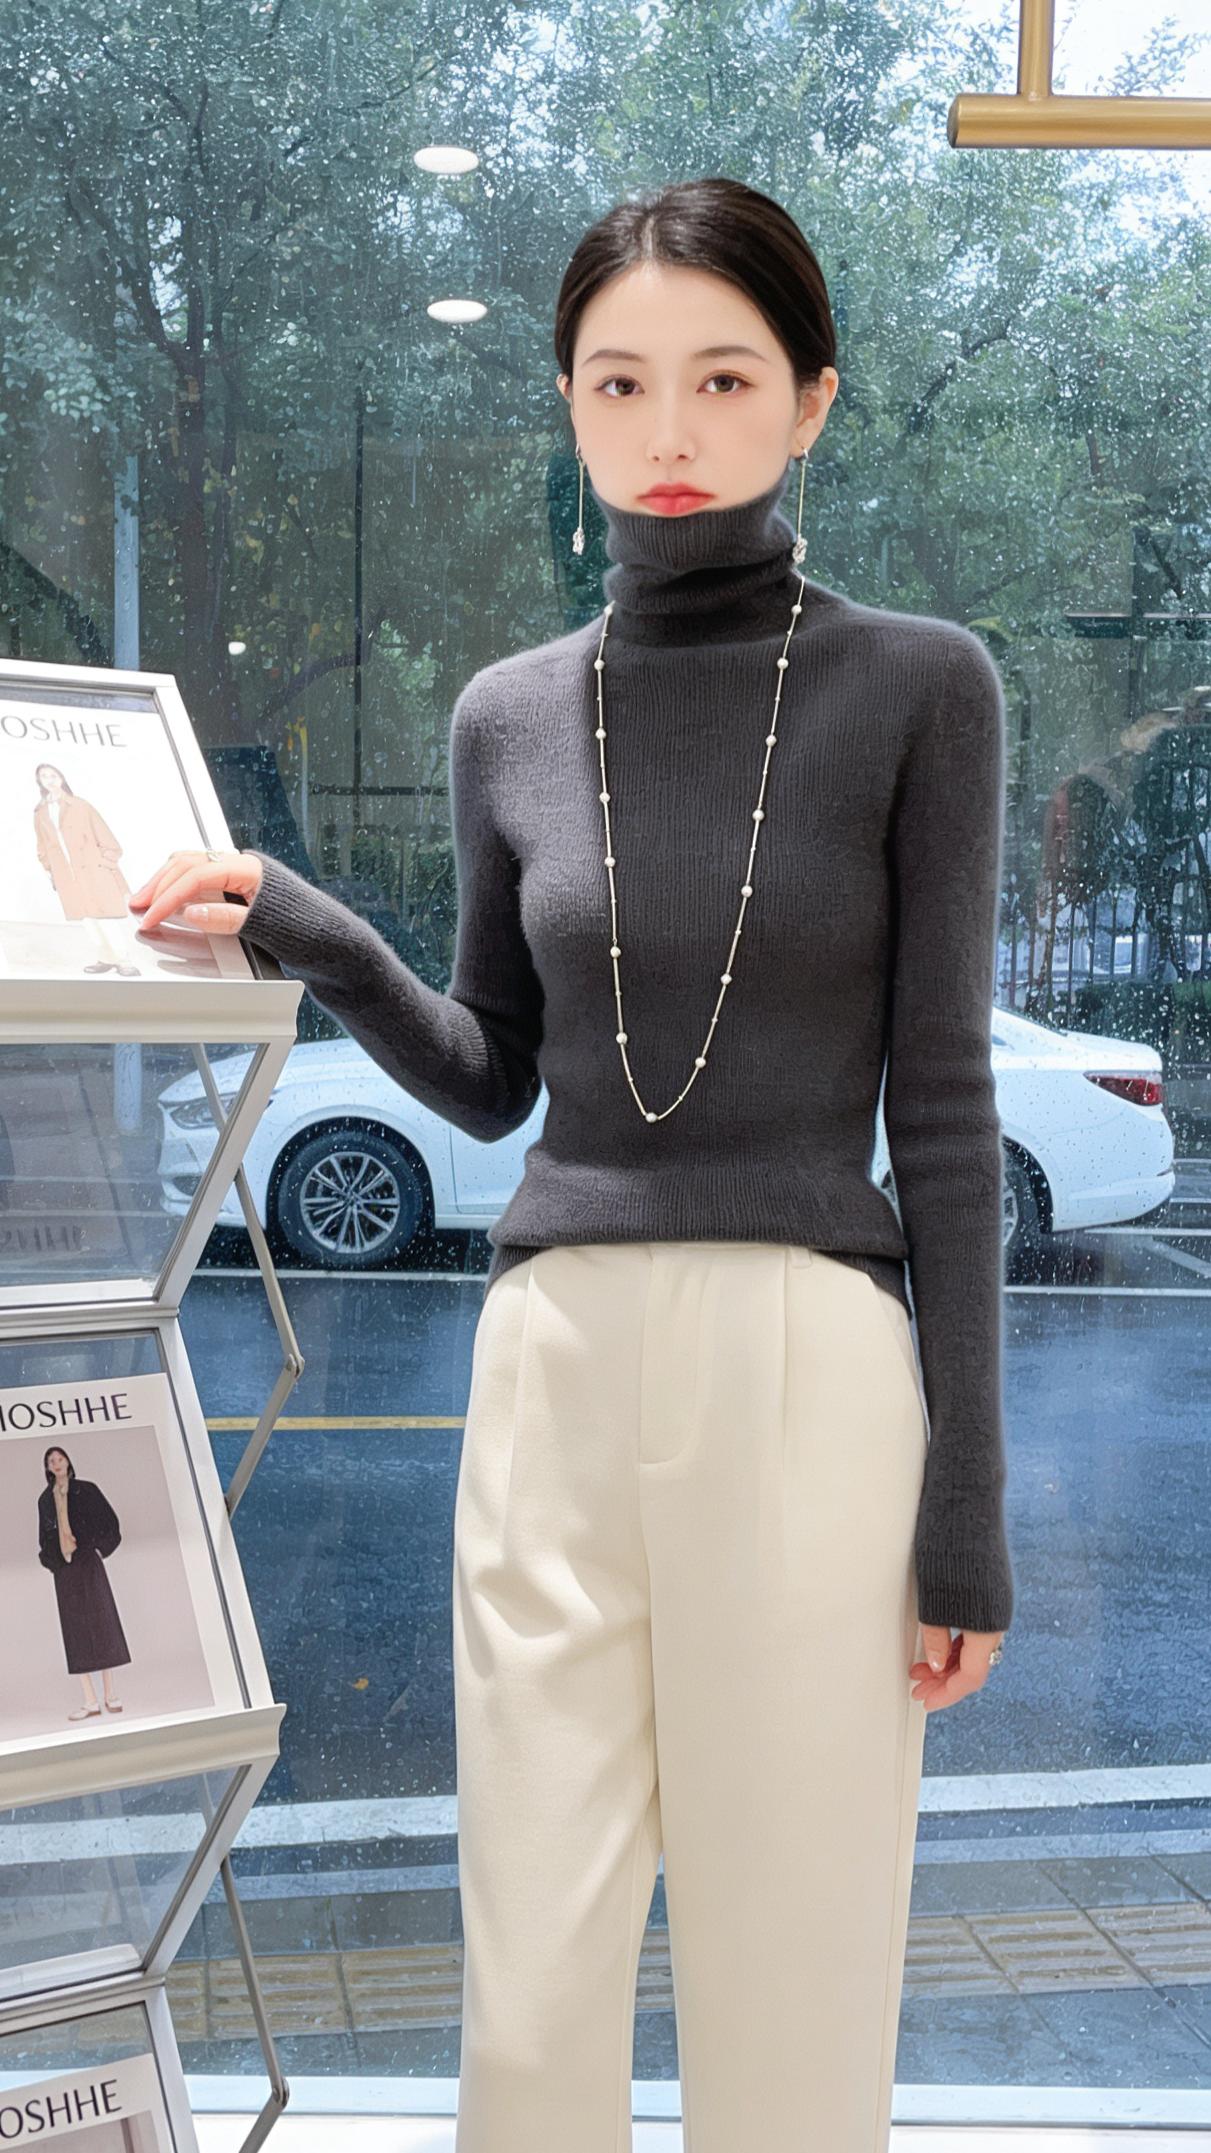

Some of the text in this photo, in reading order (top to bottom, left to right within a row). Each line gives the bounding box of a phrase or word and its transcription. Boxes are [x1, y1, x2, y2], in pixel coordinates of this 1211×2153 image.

[1, 715, 127, 747] OSHHE
[0, 1393, 132, 1431] OSHHE
[0, 2079, 122, 2139] OSHHE
